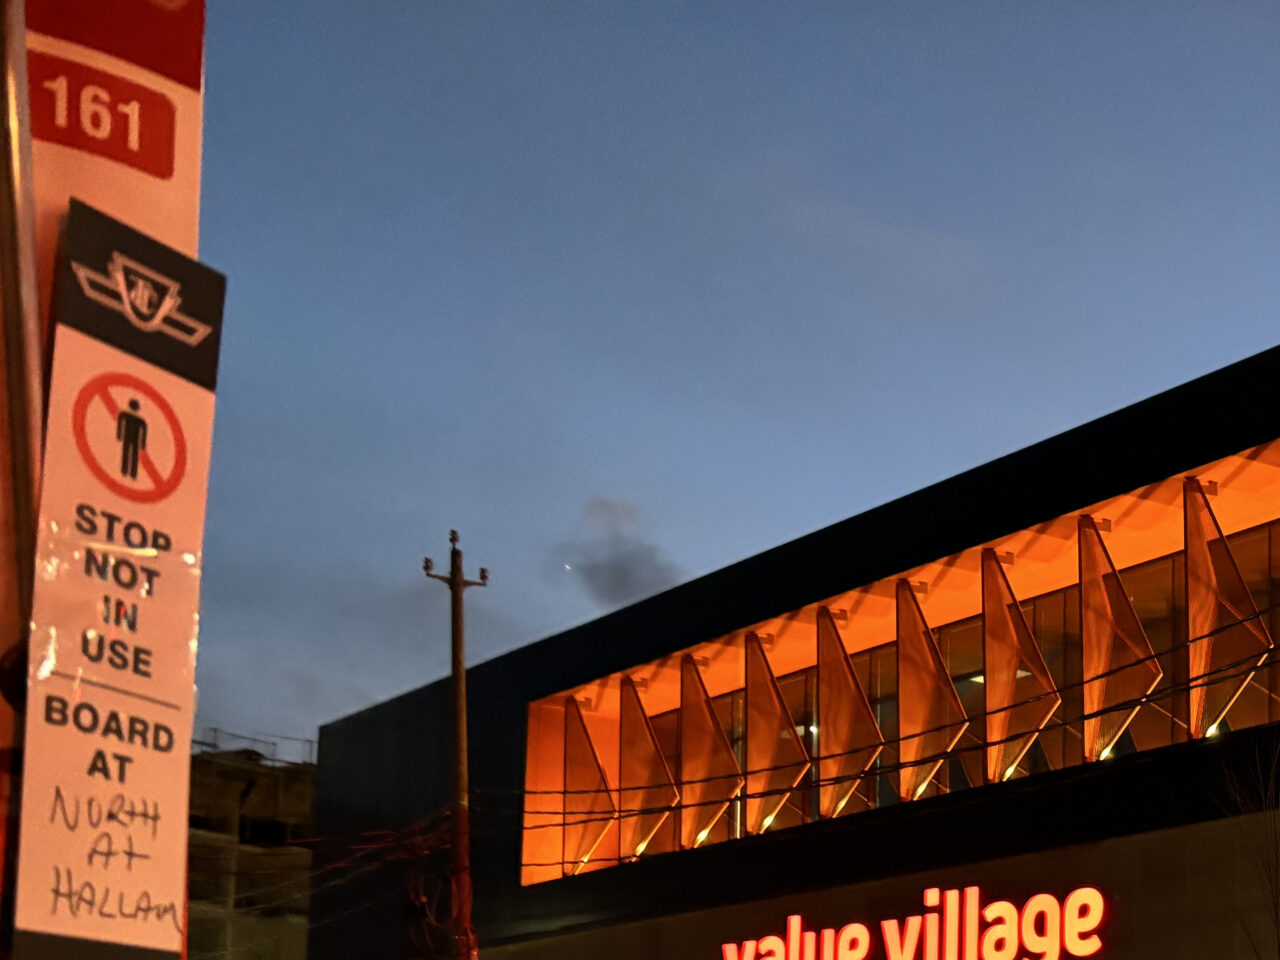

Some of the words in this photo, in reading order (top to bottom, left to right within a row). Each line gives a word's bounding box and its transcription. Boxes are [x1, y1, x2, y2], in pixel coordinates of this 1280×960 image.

[43, 75, 141, 152] 161
[75, 503, 172, 552] STOP
[84, 548, 161, 597] NOT
[101, 594, 138, 633] IN
[81, 630, 152, 679] USE
[44, 694, 174, 753] BOARD
[87, 749, 133, 784] AT
